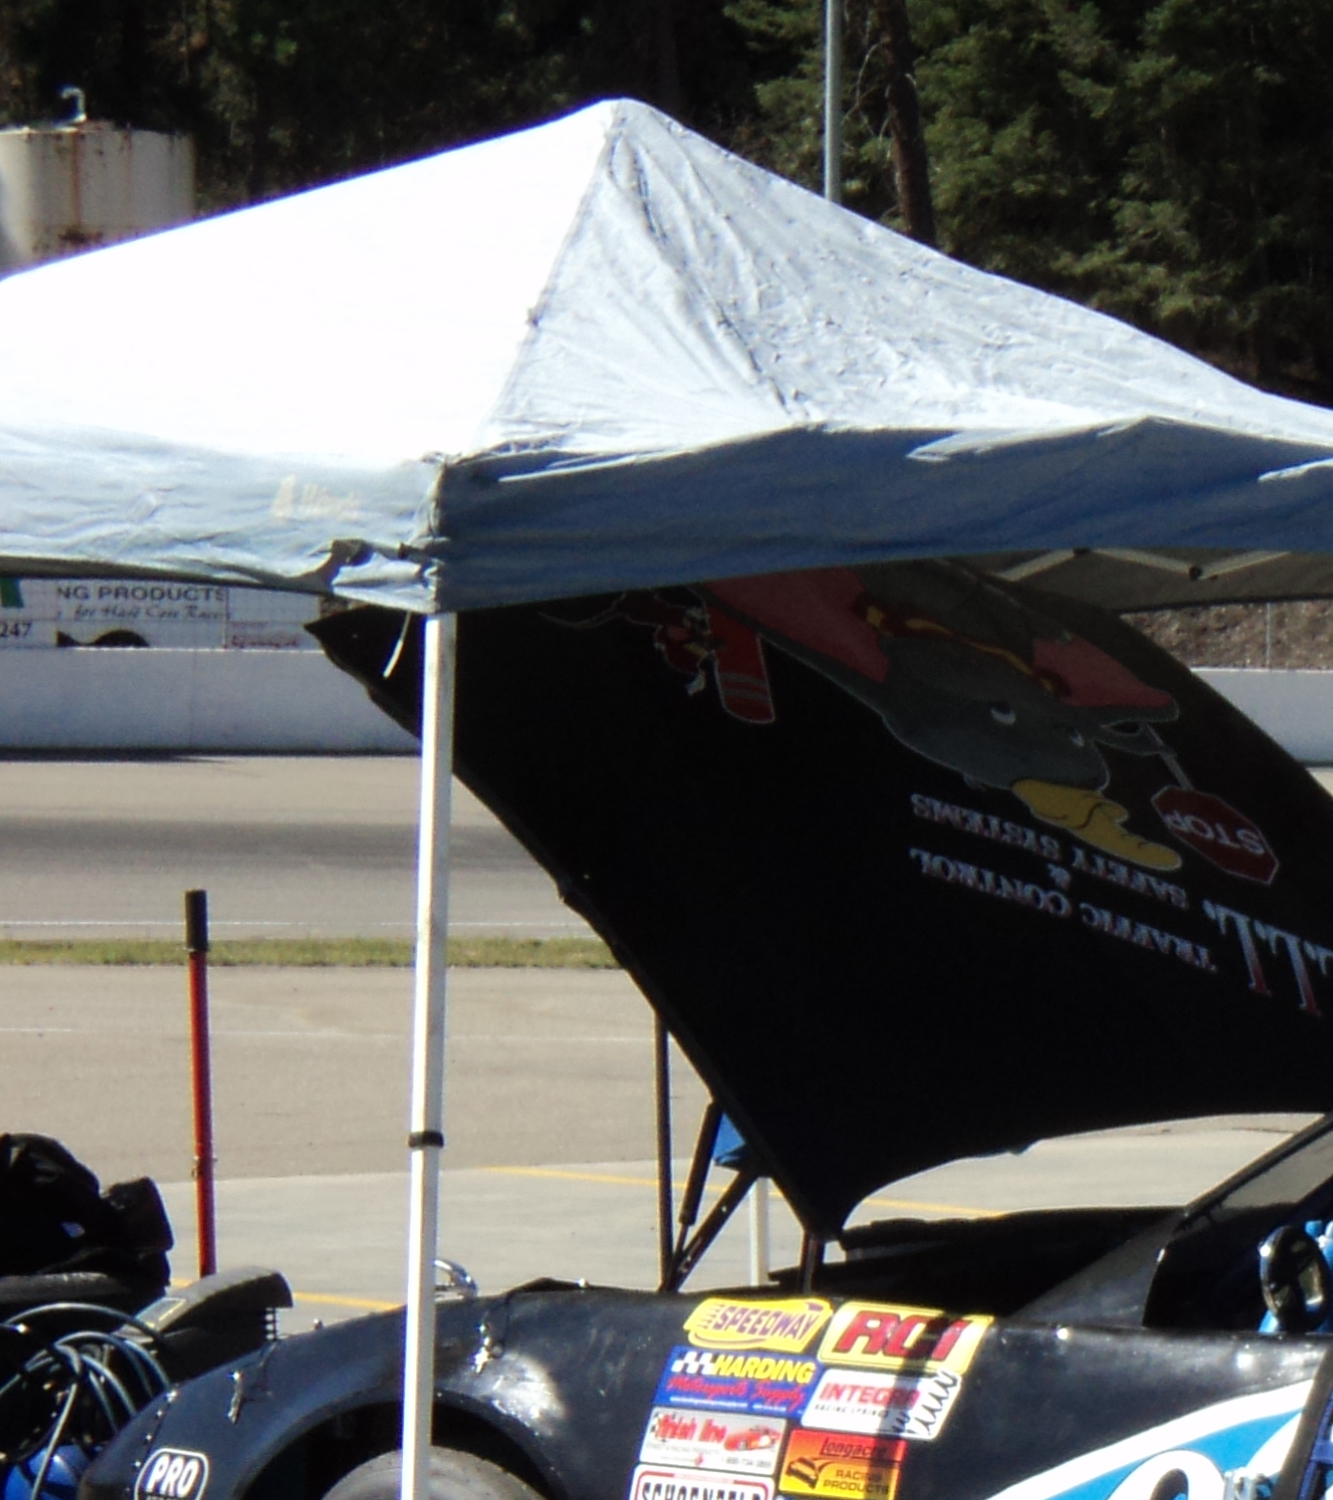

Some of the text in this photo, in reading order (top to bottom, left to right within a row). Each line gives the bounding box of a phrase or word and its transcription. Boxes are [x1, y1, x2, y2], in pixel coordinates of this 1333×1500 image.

[98, 586, 225, 602] PRODUCTS
[908, 792, 1188, 911] SAFETY SYSTEMS
[1164, 810, 1267, 858] STOP
[1046, 862, 1071, 891] &
[908, 846, 1218, 974] TRAFFIC CONTROL
[712, 1305, 819, 1341] SPEEDWAY
[713, 1353, 817, 1385] HARDING
[145, 1453, 200, 1498] PRO
[823, 1479, 890, 1496] PRODUCTS
